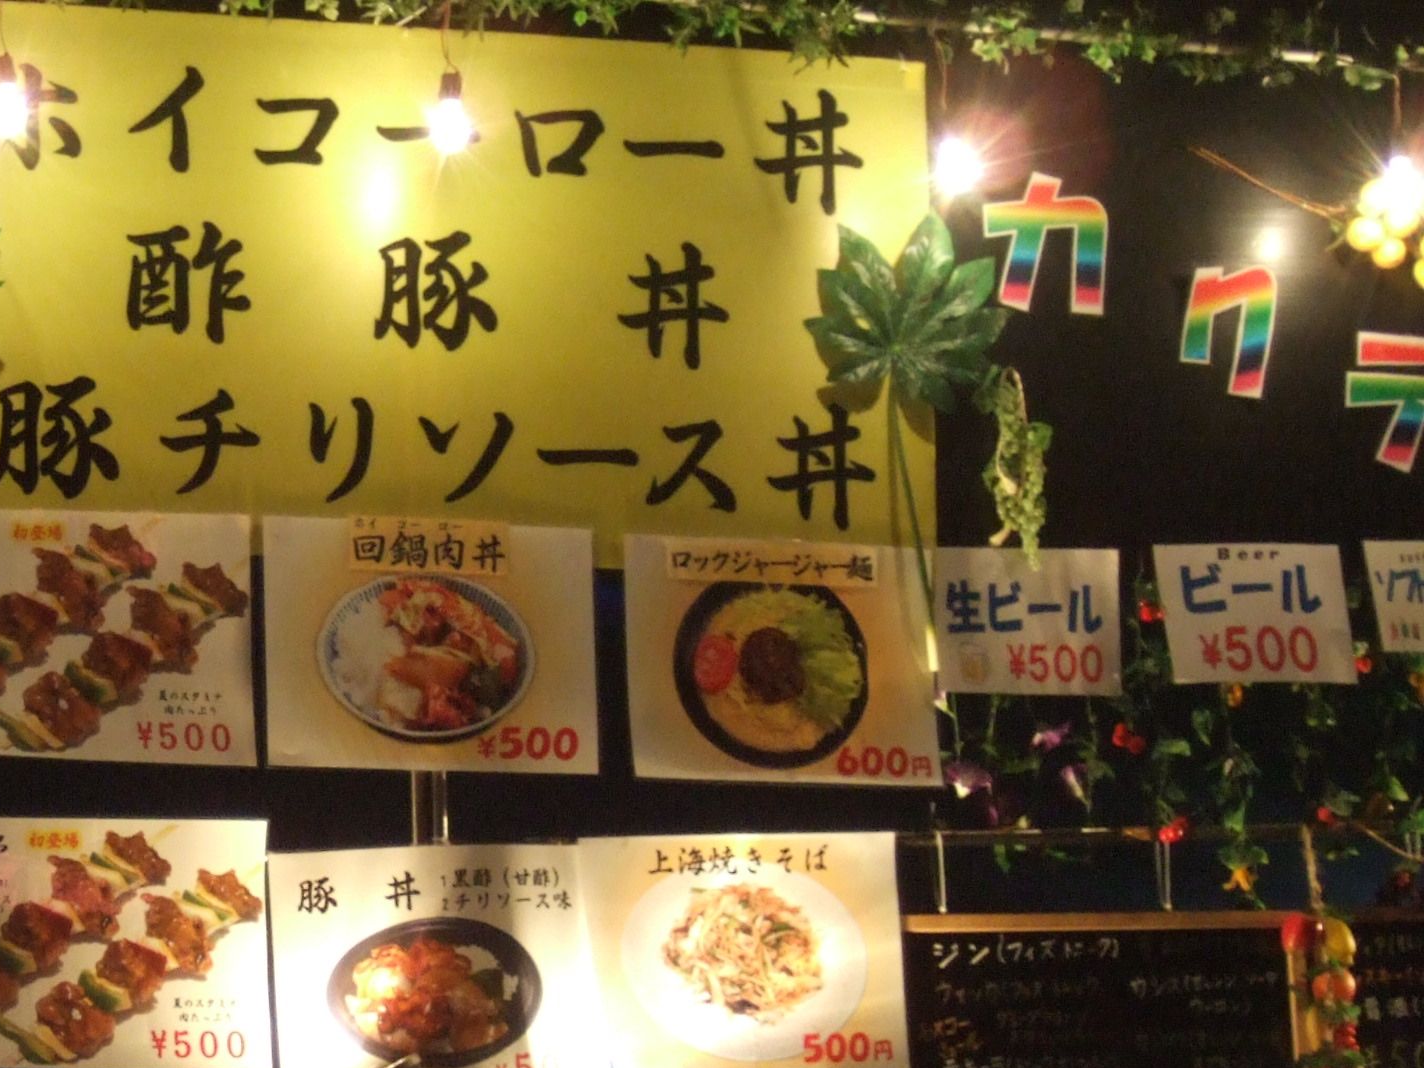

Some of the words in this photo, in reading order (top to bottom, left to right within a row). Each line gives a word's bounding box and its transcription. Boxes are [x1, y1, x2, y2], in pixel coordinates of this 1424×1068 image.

[124, 220, 731, 370] 酢豚丼
[353, 531, 506, 573] 回鍋肉丼
[1217, 547, 1280, 561] Beer
[946, 579, 1103, 636] 生ビール
[1180, 563, 1322, 614] ビール
[1008, 642, 1104, 683] ¥500
[1199, 625, 1319, 673] ¥500
[137, 721, 232, 752] ¥500
[477, 726, 579, 761] ¥500
[835, 745, 933, 778] 600円
[648, 844, 829, 876] 上海焼きそば
[297, 871, 421, 914] 豚丼
[150, 1029, 246, 1059] ¥500
[803, 1031, 894, 1064] 500円
